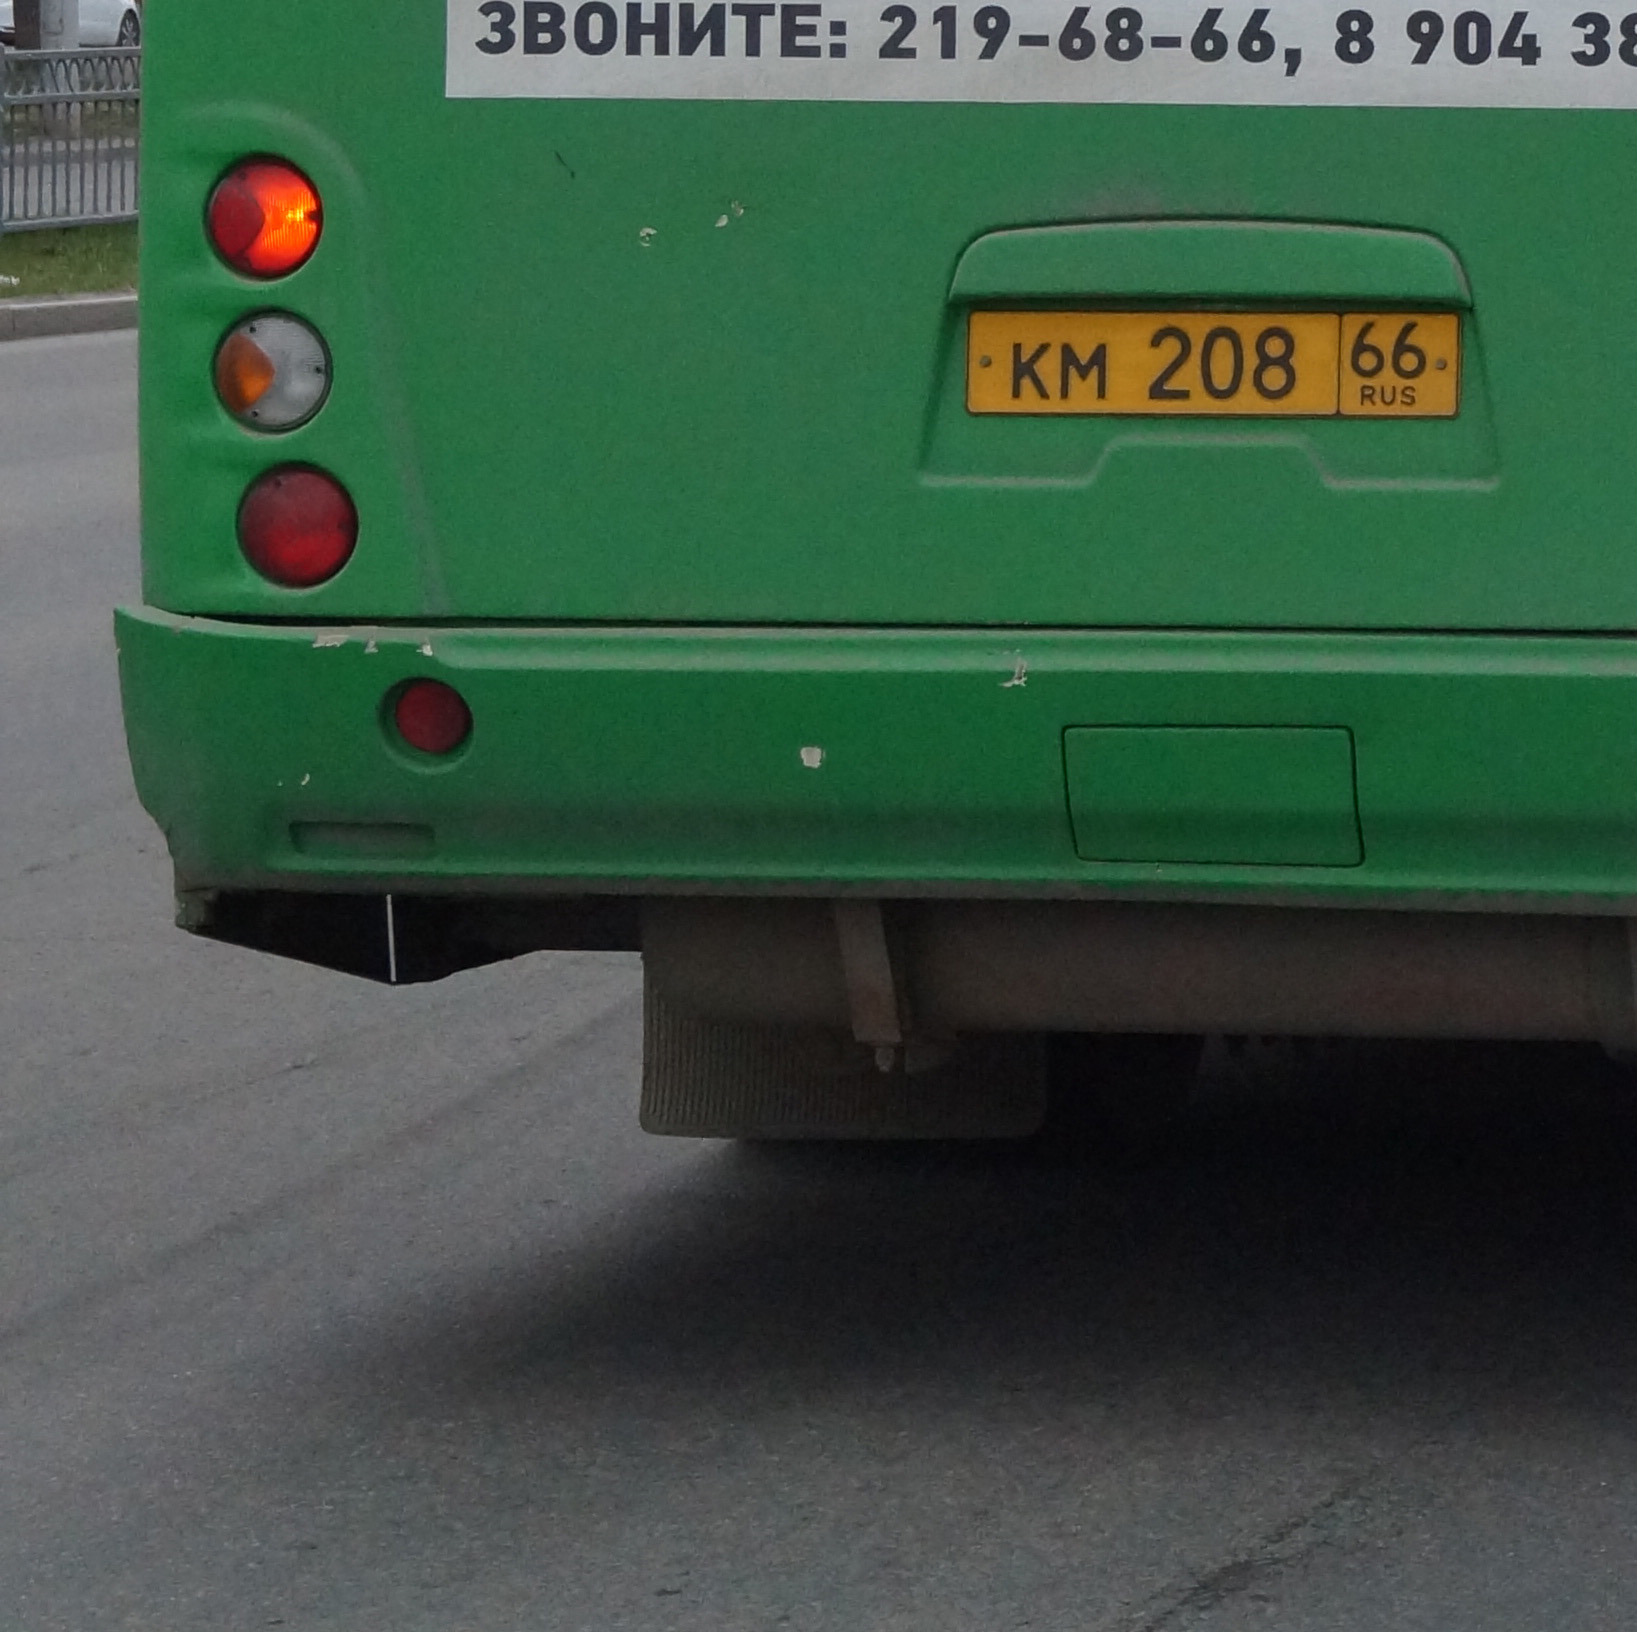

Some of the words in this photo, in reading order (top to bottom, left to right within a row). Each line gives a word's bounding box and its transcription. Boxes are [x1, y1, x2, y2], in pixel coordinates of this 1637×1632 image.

[474, 0, 849, 59] ЗВОНИТЕ:
[878, 4, 1302, 78] 219-68-66,
[1334, 8, 1377, 66] 8
[1405, 9, 1543, 68] 904
[1010, 341, 1108, 402] КМ
[1147, 325, 1298, 402] 208
[1349, 320, 1428, 380] 66
[1359, 383, 1418, 408] RUS
